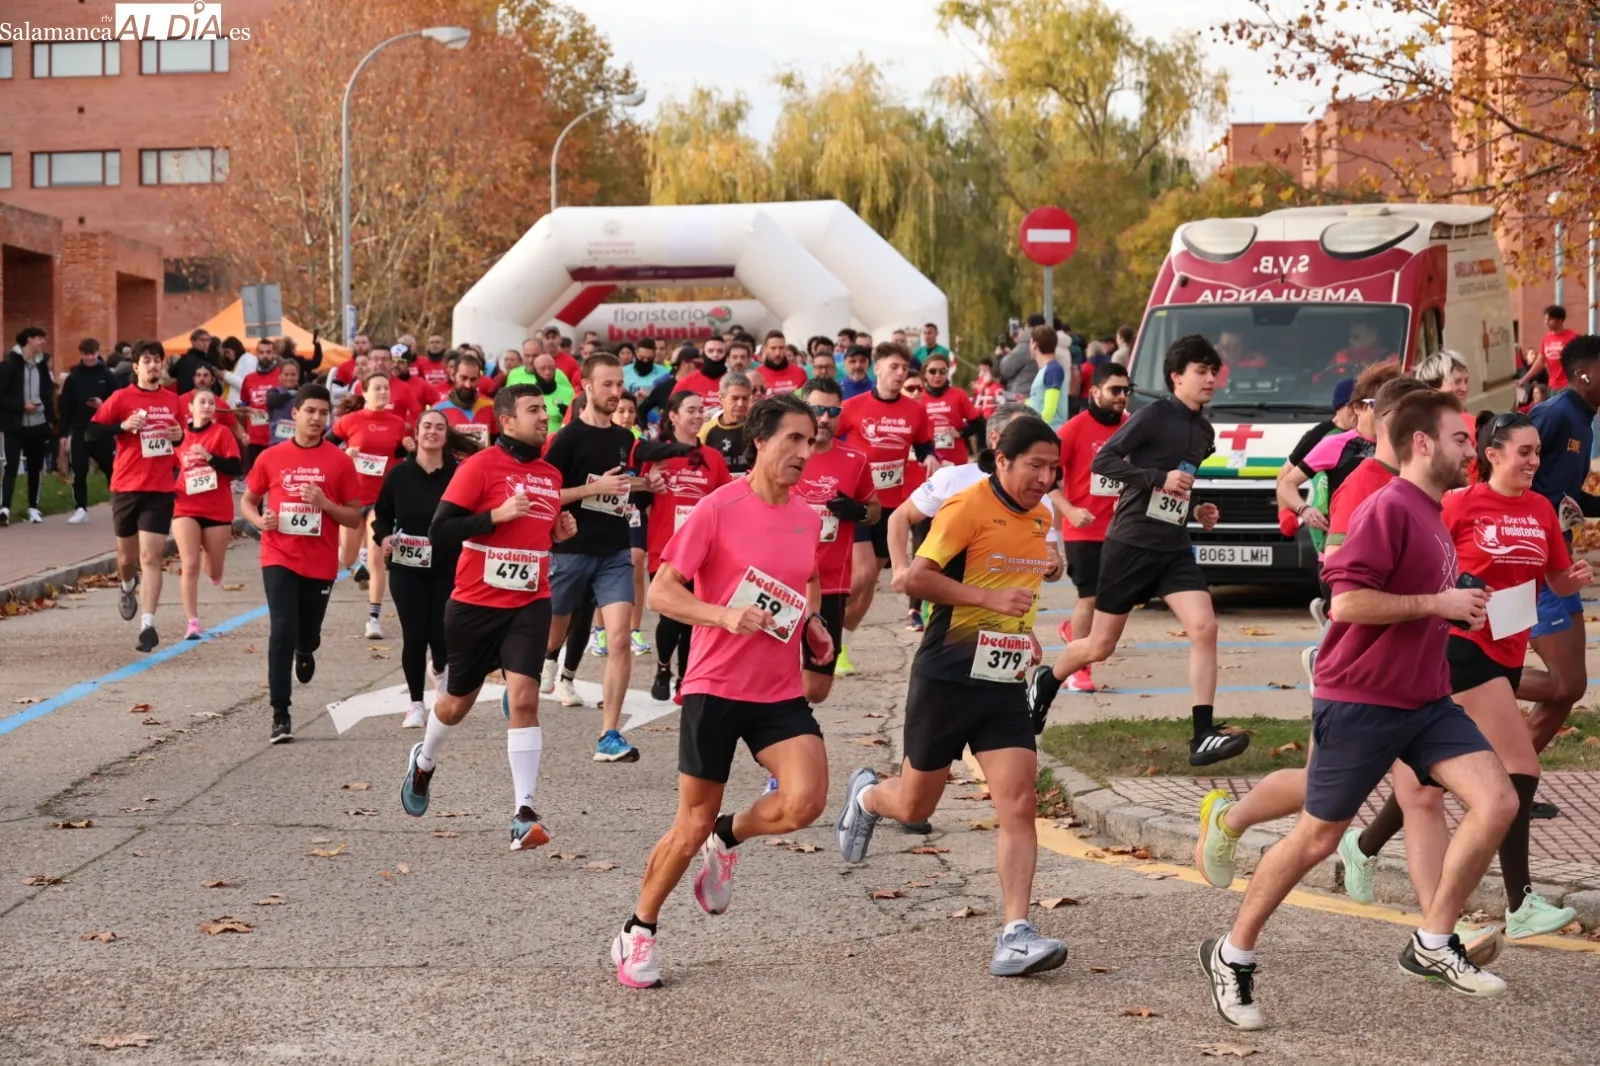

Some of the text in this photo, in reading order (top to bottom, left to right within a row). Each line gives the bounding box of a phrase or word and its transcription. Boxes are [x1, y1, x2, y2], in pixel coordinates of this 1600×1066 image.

[608, 320, 713, 342] bedunia
[148, 439, 165, 450] 449
[363, 460, 375, 470] 76
[192, 475, 211, 488] 359
[880, 470, 895, 482] 99
[1159, 496, 1185, 517] 394
[291, 514, 308, 527] 66
[399, 544, 423, 559] 954
[487, 549, 539, 563] bedunia
[1199, 548, 1269, 562] 8063 LMH
[496, 562, 529, 580] 476
[744, 569, 805, 613] bedunia
[754, 592, 782, 617] 59
[980, 633, 1031, 650] bedunia
[987, 649, 1022, 671] 379
